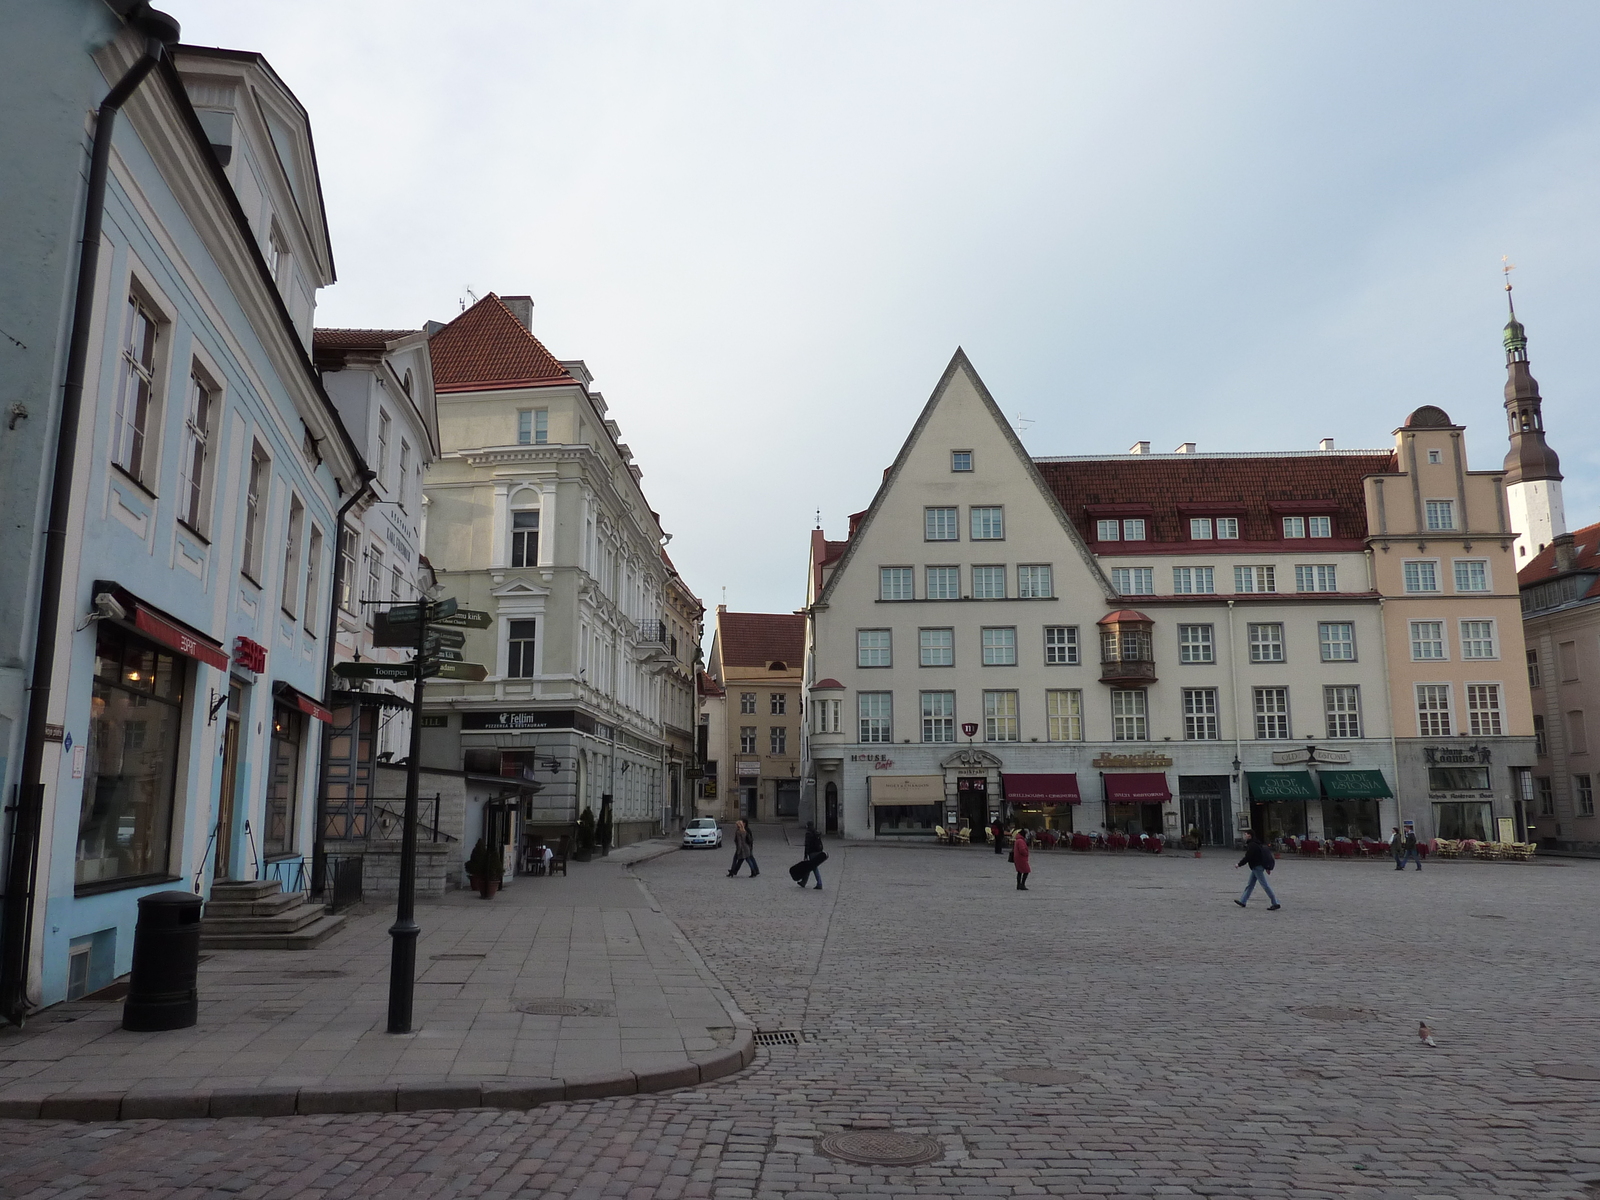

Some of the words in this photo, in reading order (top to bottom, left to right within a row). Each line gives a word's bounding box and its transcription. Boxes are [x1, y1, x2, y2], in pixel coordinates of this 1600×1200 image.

[181, 636, 197, 656] ESPRIT
[374, 667, 408, 677] Toompea
[440, 664, 456, 672] adam
[510, 712, 535, 723] Fellini
[1439, 746, 1463, 755] Vana
[850, 754, 888, 762] HOUSE
[1317, 752, 1348, 760] ESTONIA
[1424, 747, 1475, 766] Toomas
[1335, 773, 1369, 782] OLDE
[1264, 778, 1298, 787] OLDE
[1331, 781, 1382, 789] ESTONIA
[1259, 786, 1310, 795] ESTONIA
